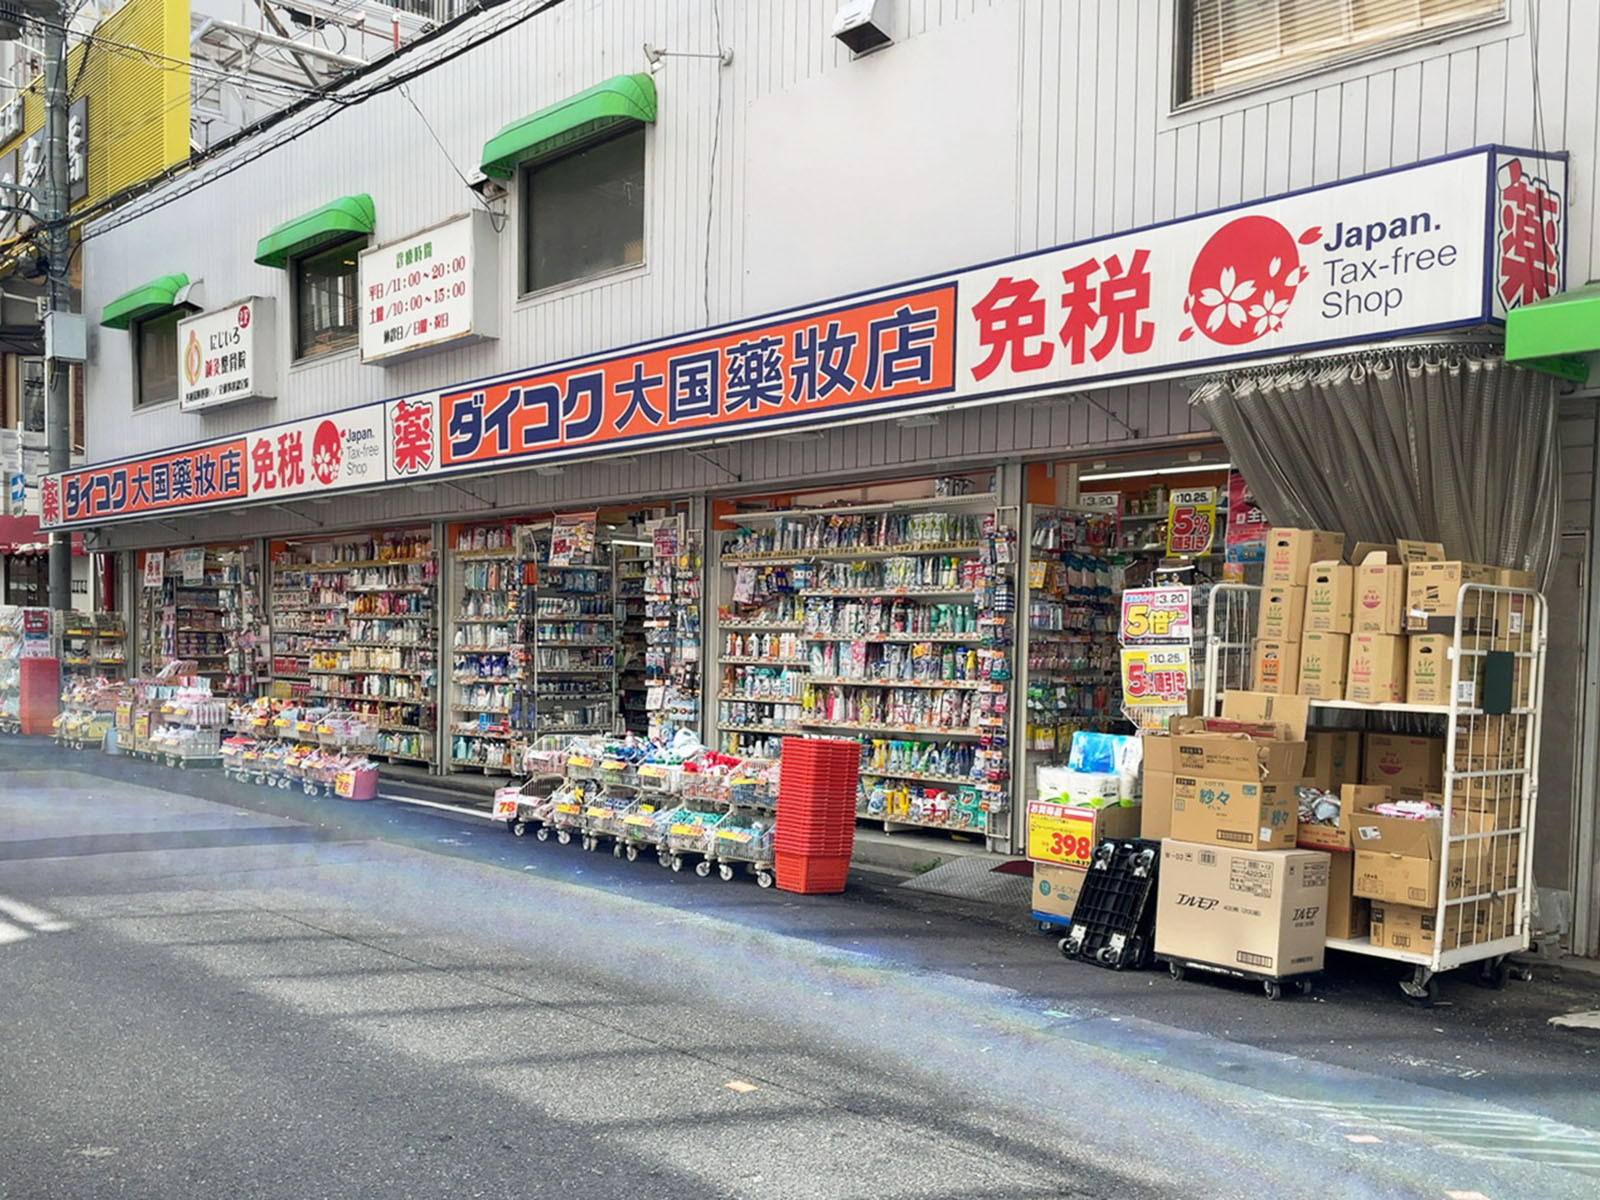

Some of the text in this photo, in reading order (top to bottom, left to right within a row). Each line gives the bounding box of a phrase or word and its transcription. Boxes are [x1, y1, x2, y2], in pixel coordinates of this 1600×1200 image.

[1323, 211, 1441, 252] Japan.
[1498, 158, 1561, 312] 薬
[1323, 244, 1457, 287] Tax-free
[970, 248, 1156, 382] 免税
[1321, 287, 1403, 319] Shop
[209, 326, 241, 351] にじいろ
[346, 428, 375, 444] Japan.
[346, 444, 380, 460] Tax-free
[391, 399, 433, 474] 薬
[251, 431, 303, 493] 免税
[346, 462, 368, 477] Shop
[41, 476, 59, 525] 薬
[499, 801, 516, 813] 78
[1050, 832, 1090, 860] 398
